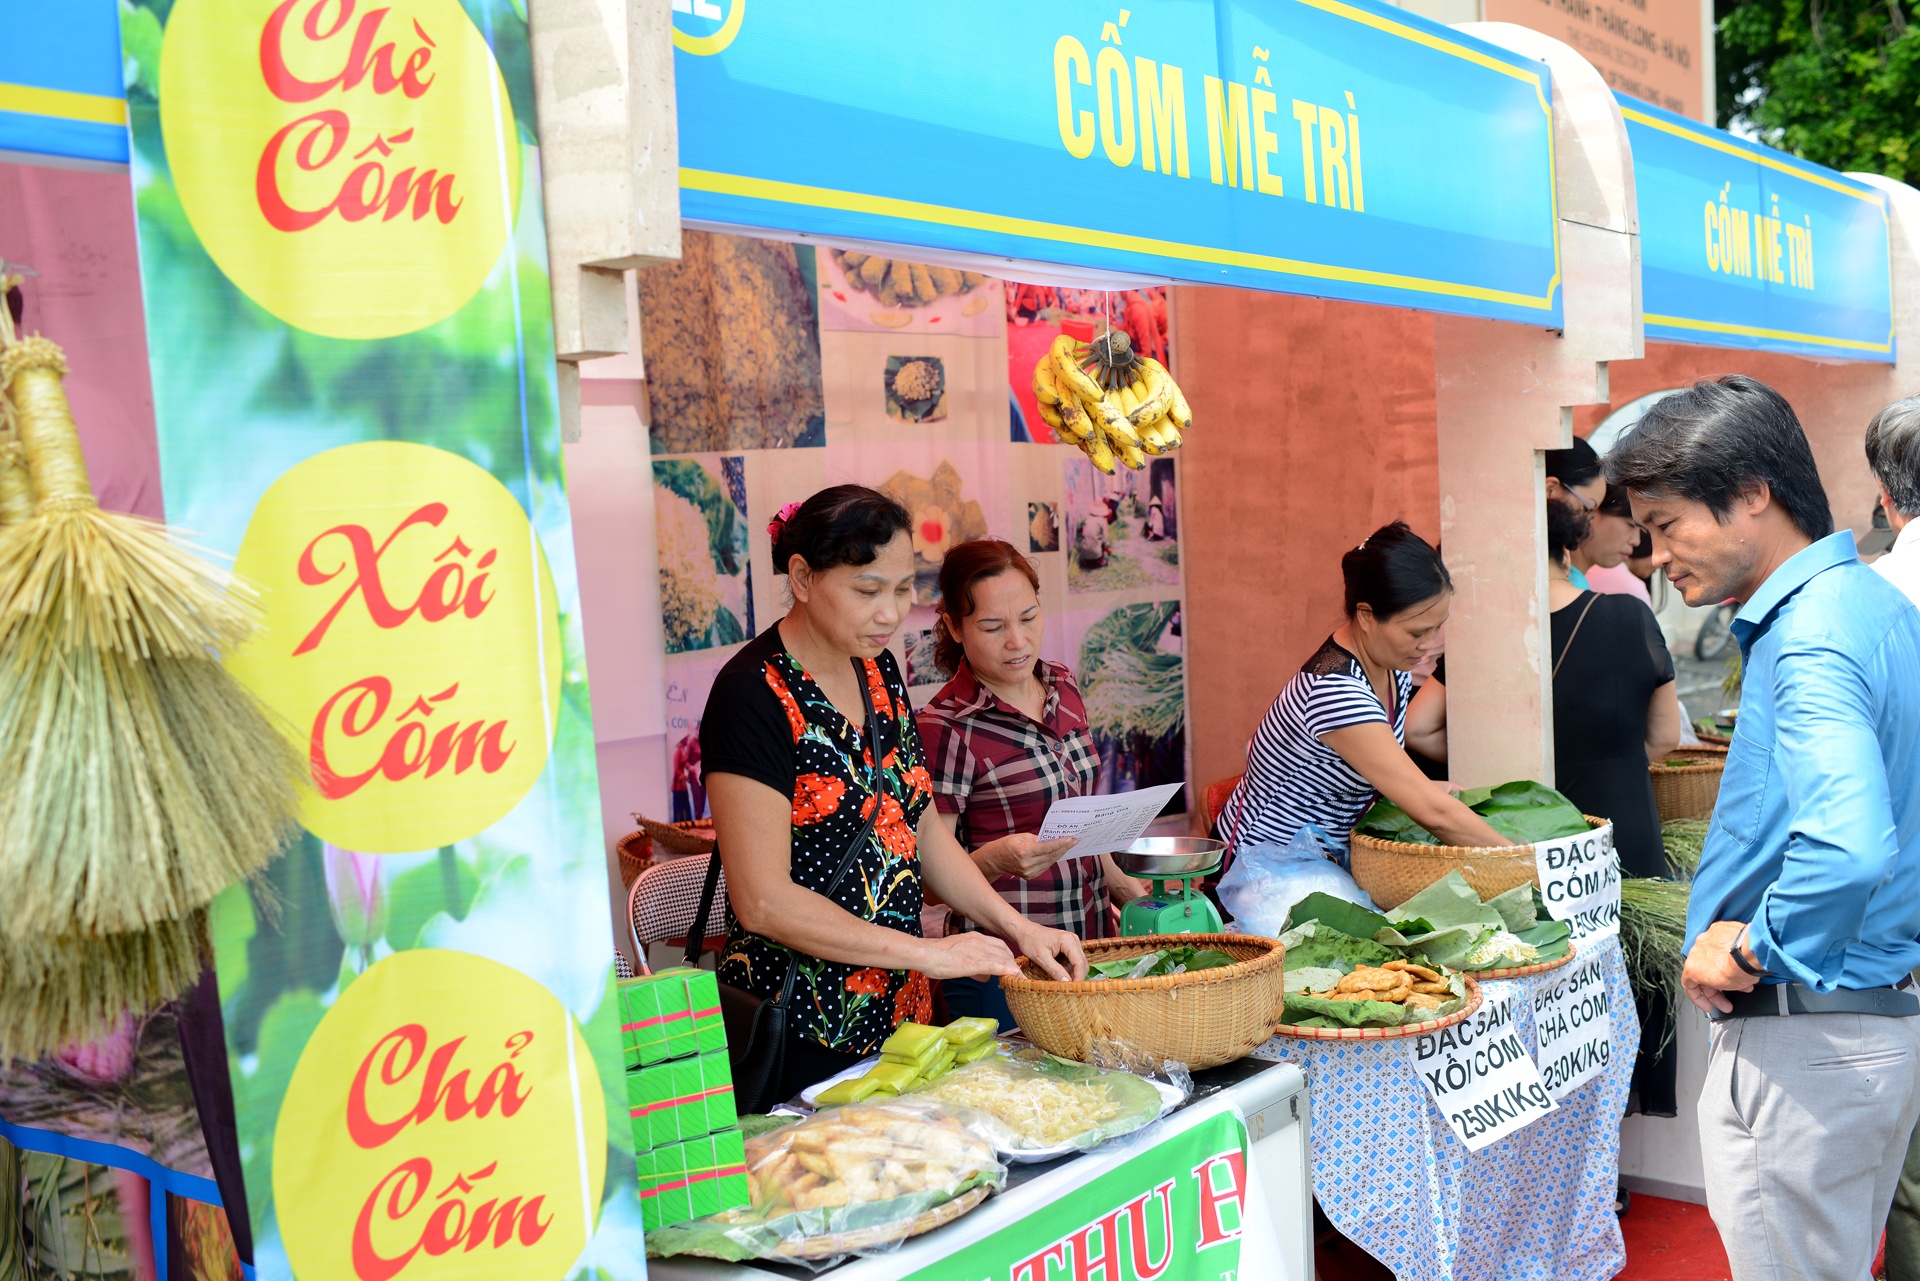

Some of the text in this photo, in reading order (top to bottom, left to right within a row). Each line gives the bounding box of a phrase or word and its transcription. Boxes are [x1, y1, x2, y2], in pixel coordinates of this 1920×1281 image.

[260, 0, 436, 103] Chè
[1053, 8, 1364, 213] CỐM MỄ TRÌ
[256, 109, 463, 233] Cốm
[1704, 181, 1814, 290] CỐM MỄ TRÌ
[292, 502, 497, 656] Xôi
[309, 676, 516, 800] Cốm
[1546, 839, 1595, 870] ĐẶC
[1547, 871, 1599, 902] CỐM
[1565, 900, 1620, 939] 250K/K
[1425, 1034, 1525, 1097] XÔI CỐM
[1539, 992, 1608, 1048] CHẢ CỐM
[1543, 1038, 1610, 1091] 250K/Kg
[347, 1023, 534, 1149] Chả
[1452, 1081, 1550, 1139] 250K/Kg
[352, 1157, 554, 1281] Cốm
